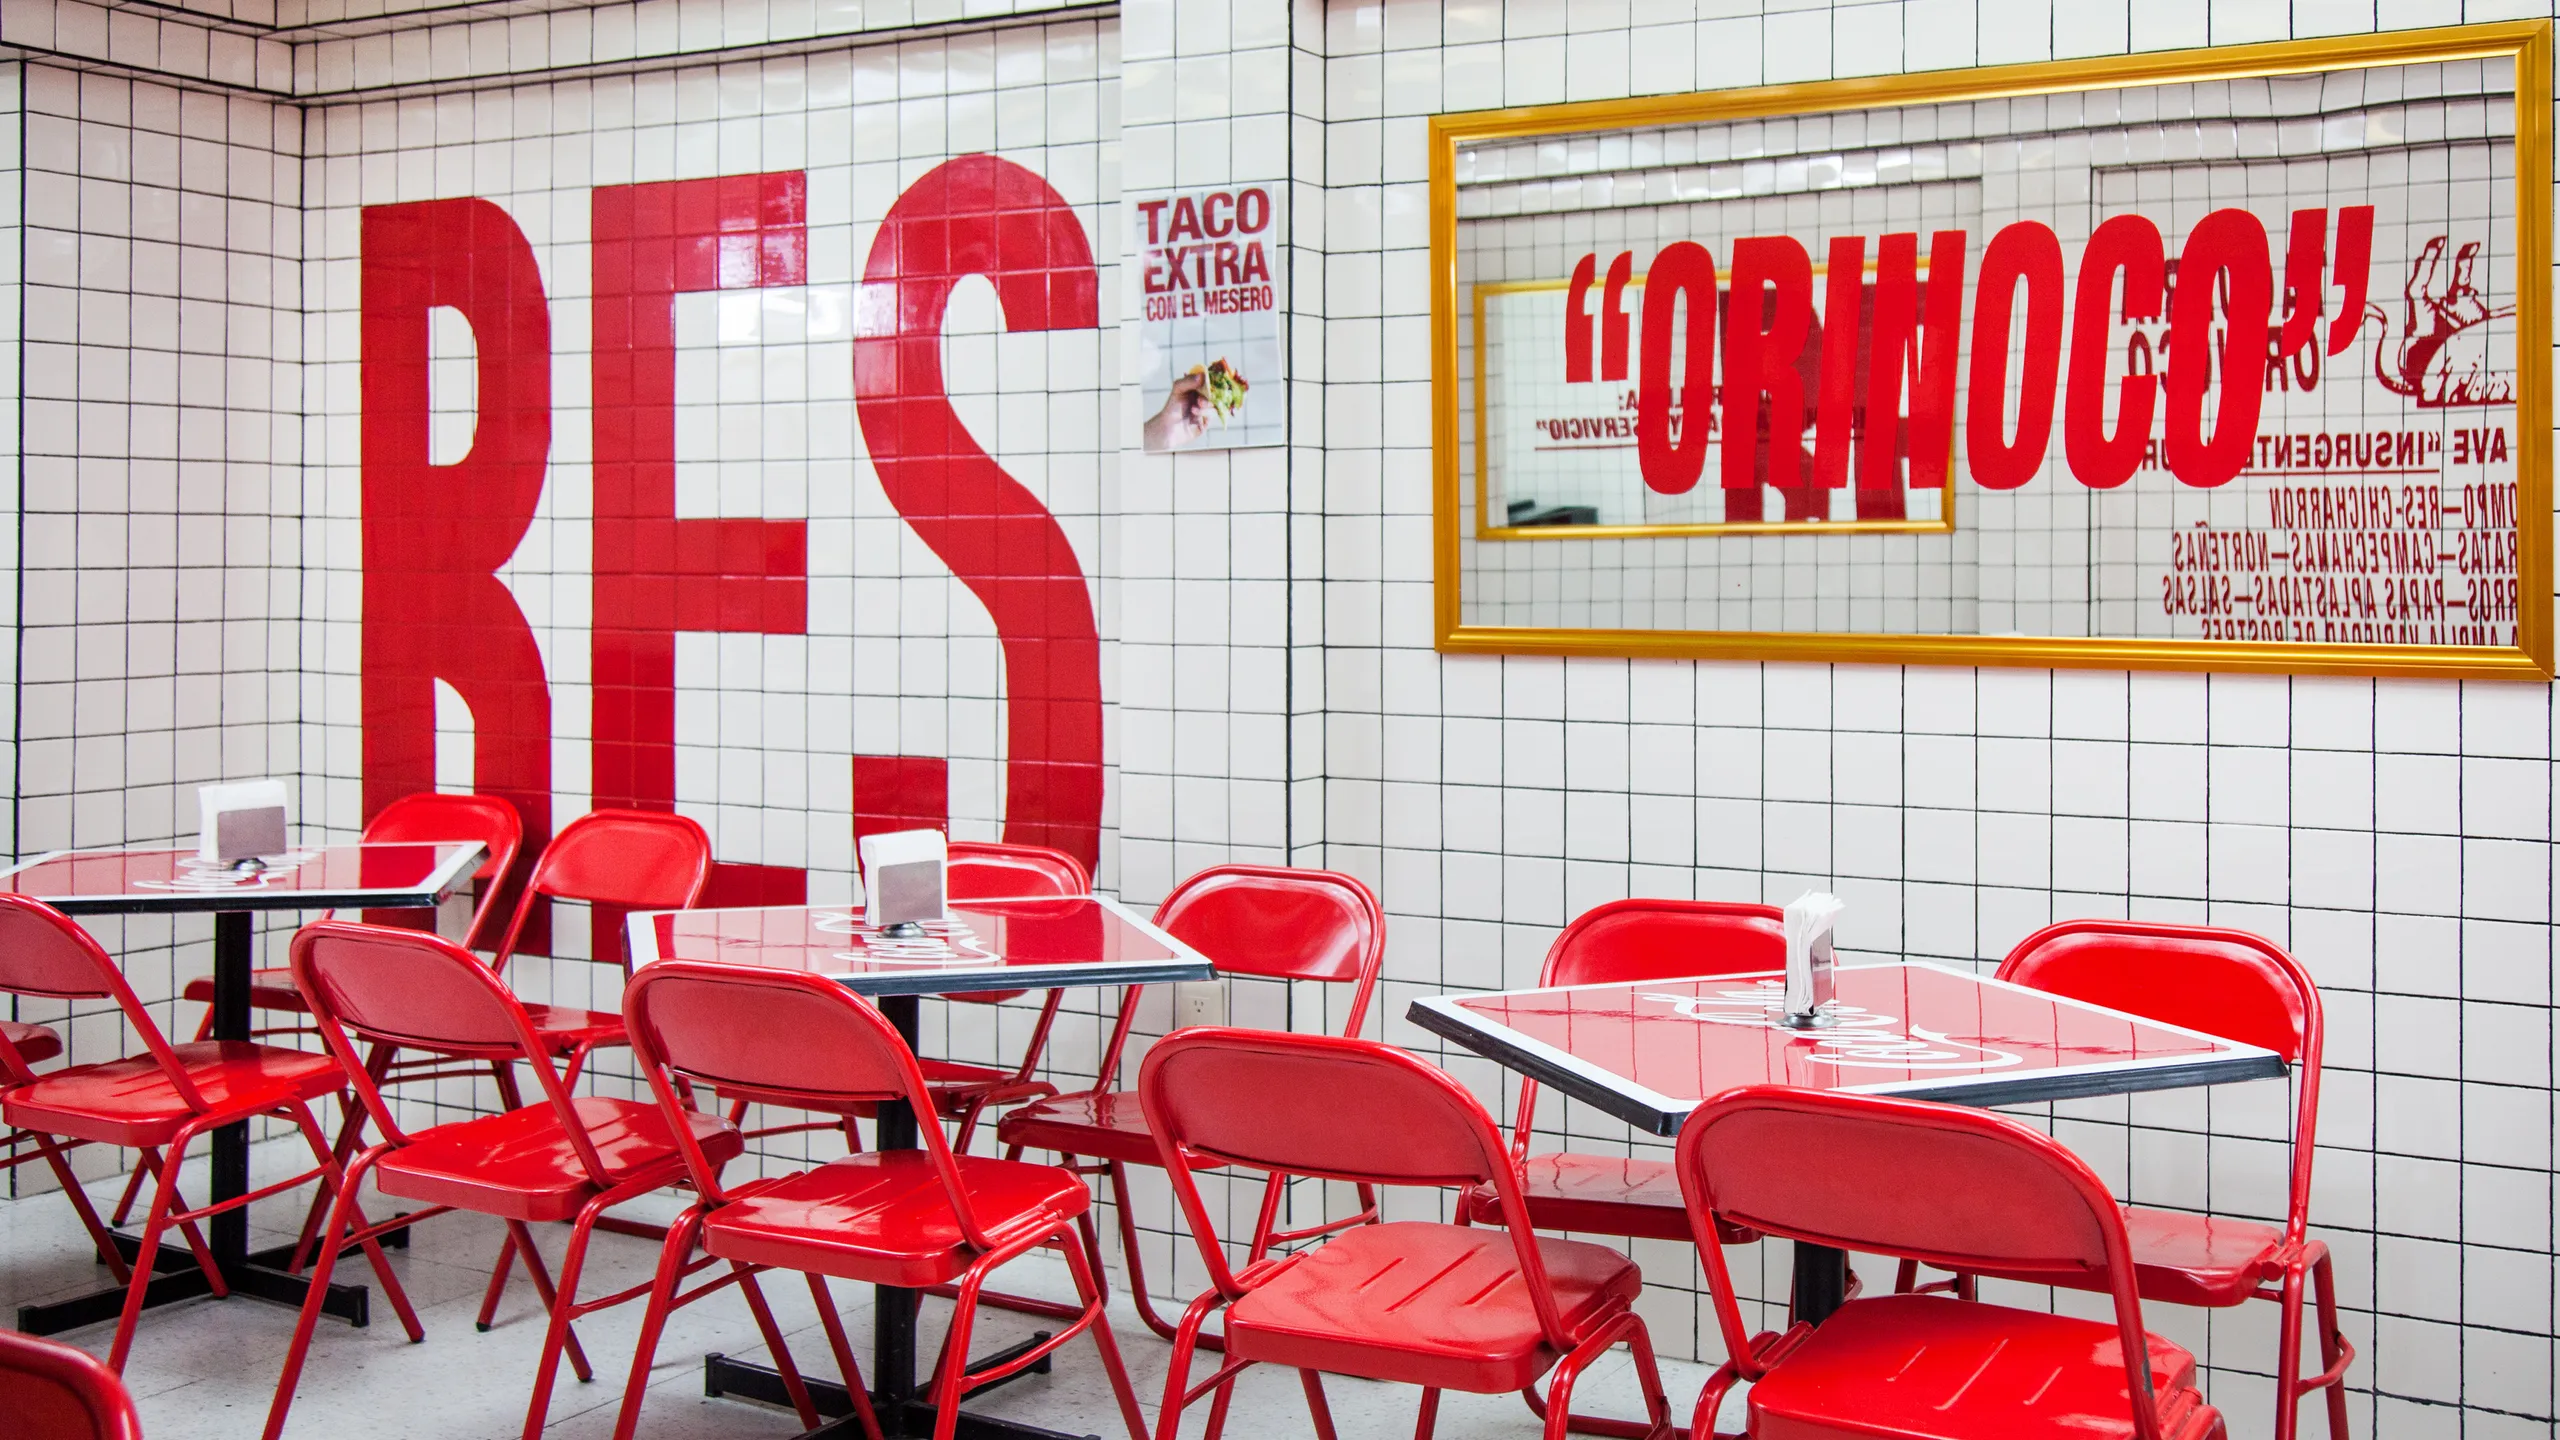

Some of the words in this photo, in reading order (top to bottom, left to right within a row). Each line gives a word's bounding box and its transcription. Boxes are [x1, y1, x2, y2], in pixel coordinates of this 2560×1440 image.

[1137, 188, 1270, 245] TACO
[1143, 240, 1270, 294] EXTRA
[1146, 296, 1177, 322] CON
[1182, 292, 1200, 318] EL
[1204, 286, 1273, 314] MESERO
[361, 152, 1104, 963] RES
